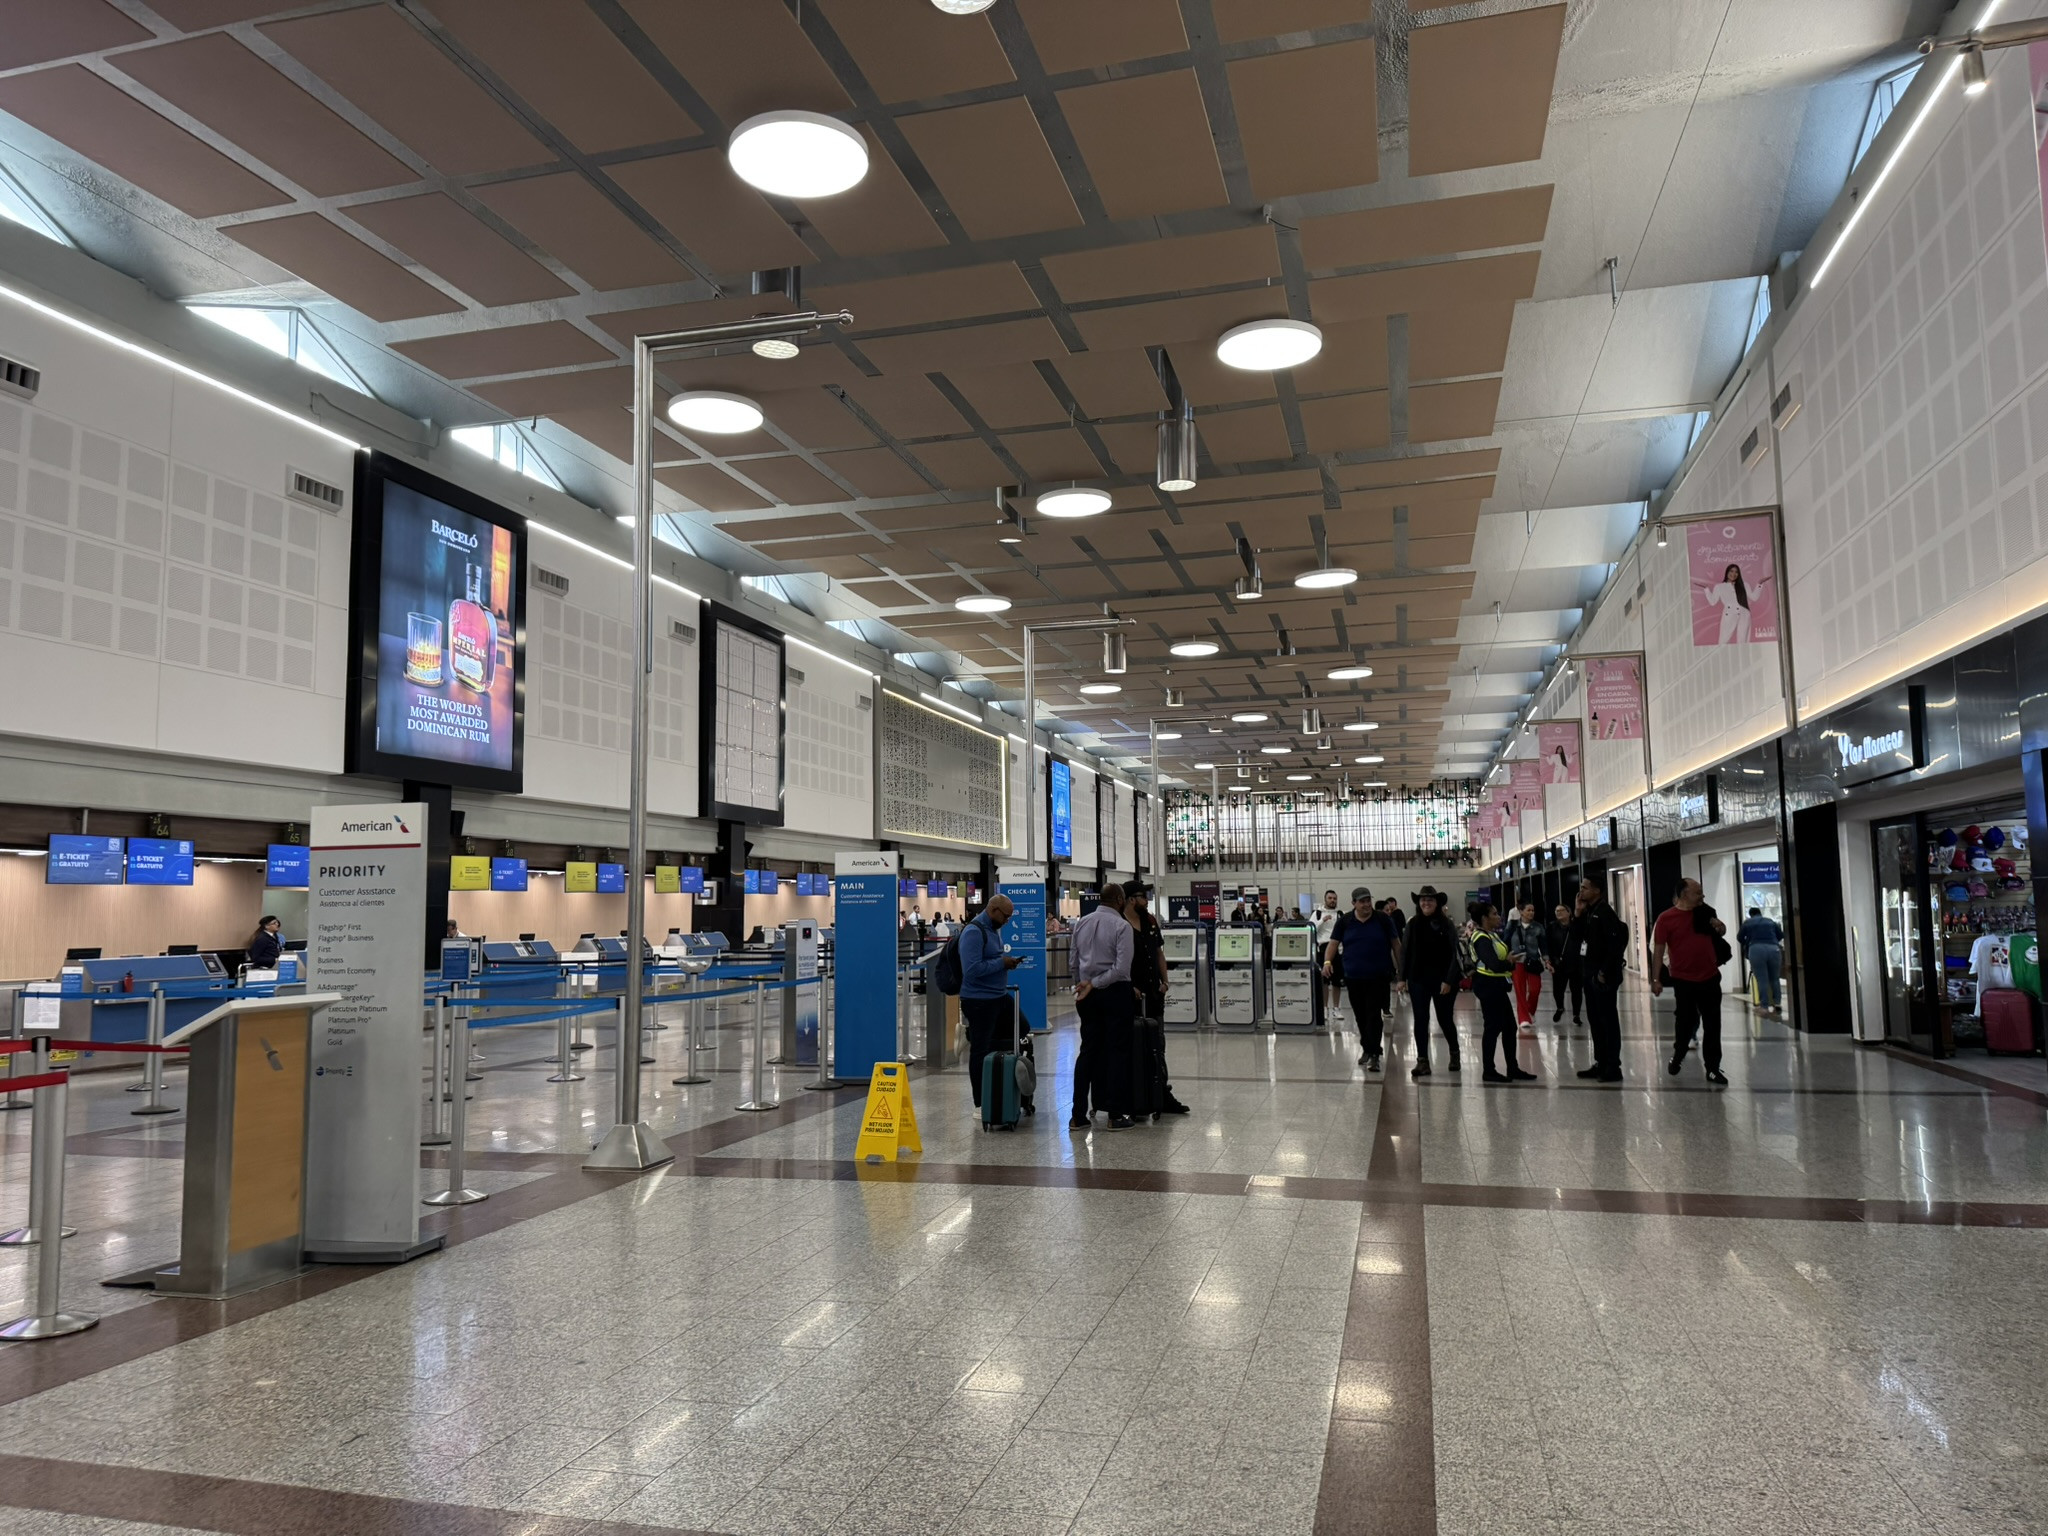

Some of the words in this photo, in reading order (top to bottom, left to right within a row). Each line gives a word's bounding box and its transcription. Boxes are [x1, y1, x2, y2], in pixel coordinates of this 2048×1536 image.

[431, 519, 478, 548] BARCELÓ
[417, 693, 438, 708] THE
[410, 705, 439, 721] MOST
[439, 712, 488, 731] AWARDED
[407, 718, 467, 739] DOMINICAN
[469, 729, 490, 744] RUM
[341, 820, 392, 833] American
[320, 865, 386, 877] PRIORITY
[319, 888, 356, 897] Customer
[356, 887, 396, 896] Assistance
[840, 882, 864, 890] MAIN
[347, 934, 374, 942] Business
[317, 957, 344, 965] Business
[317, 967, 346, 975] Premium
[347, 967, 376, 977] Economy
